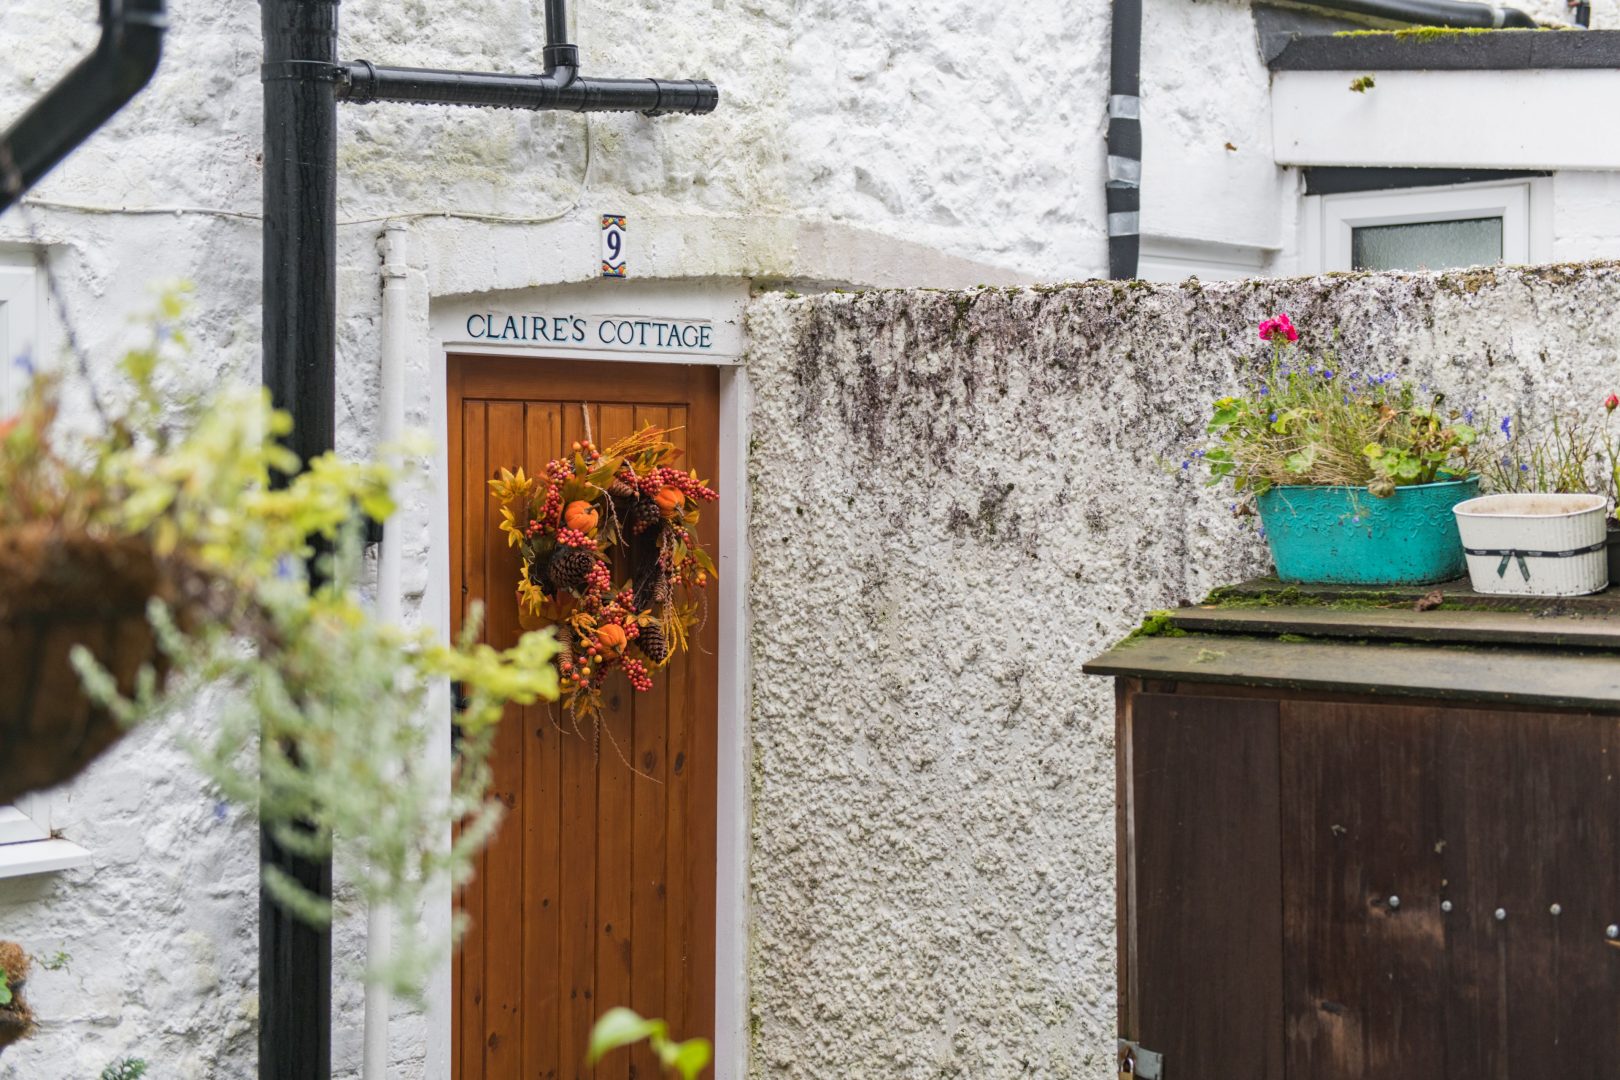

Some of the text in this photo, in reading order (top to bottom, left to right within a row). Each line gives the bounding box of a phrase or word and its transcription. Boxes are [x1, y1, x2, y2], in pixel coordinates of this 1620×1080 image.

[606, 229, 622, 261] 9
[466, 314, 713, 348] CLAIRE'S COTTAGE
